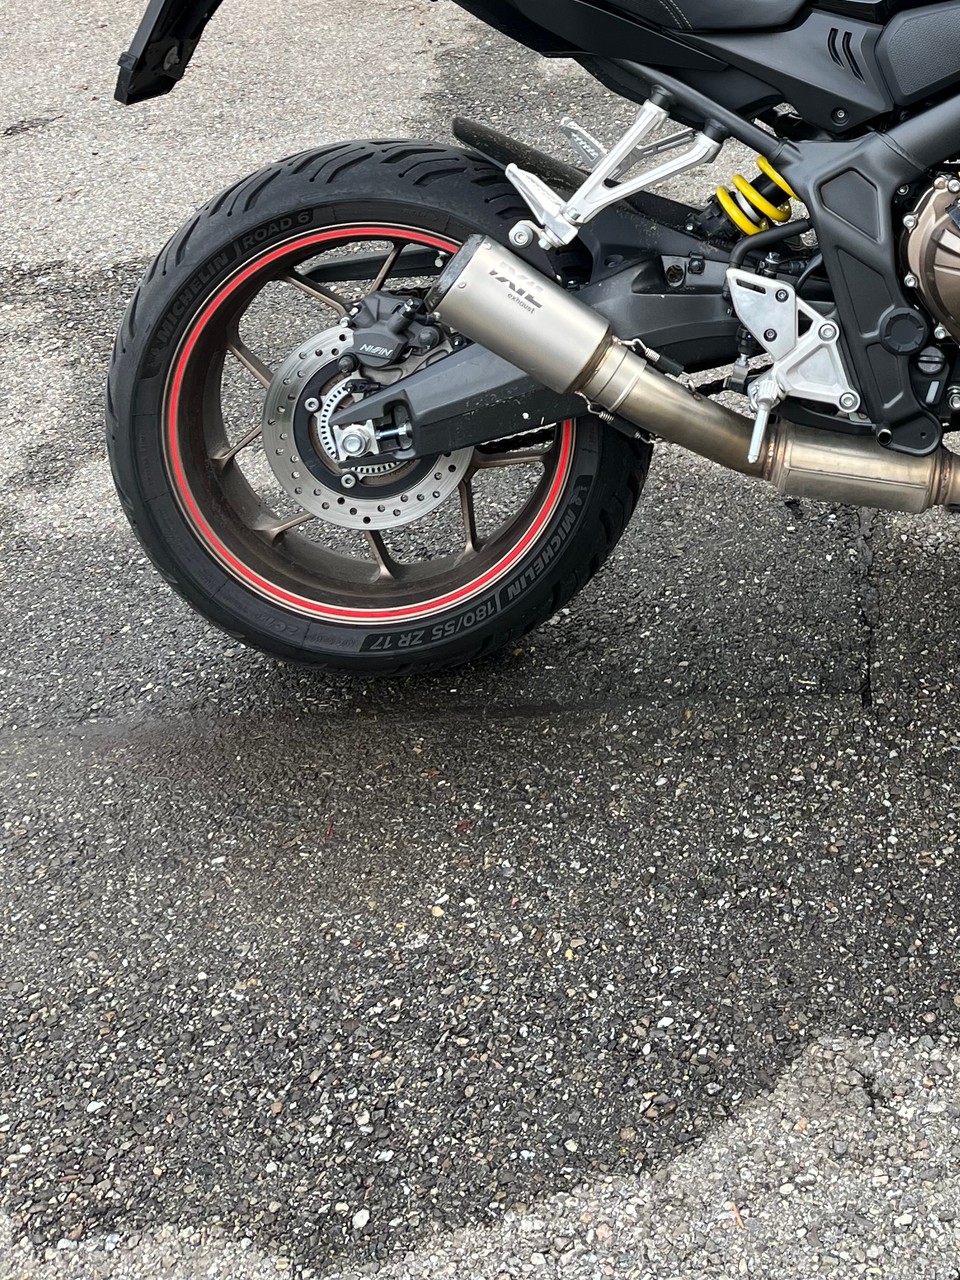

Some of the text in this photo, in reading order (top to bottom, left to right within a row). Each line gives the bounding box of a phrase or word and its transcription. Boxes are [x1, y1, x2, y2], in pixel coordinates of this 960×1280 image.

[157, 212, 310, 344] MICHELIN ROAD 6
[507, 293, 535, 315] exhaust
[508, 511, 577, 601] MICHELIN
[431, 602, 496, 639] 180/55
[370, 636, 392, 650] 17
[398, 630, 424, 648] ZR
